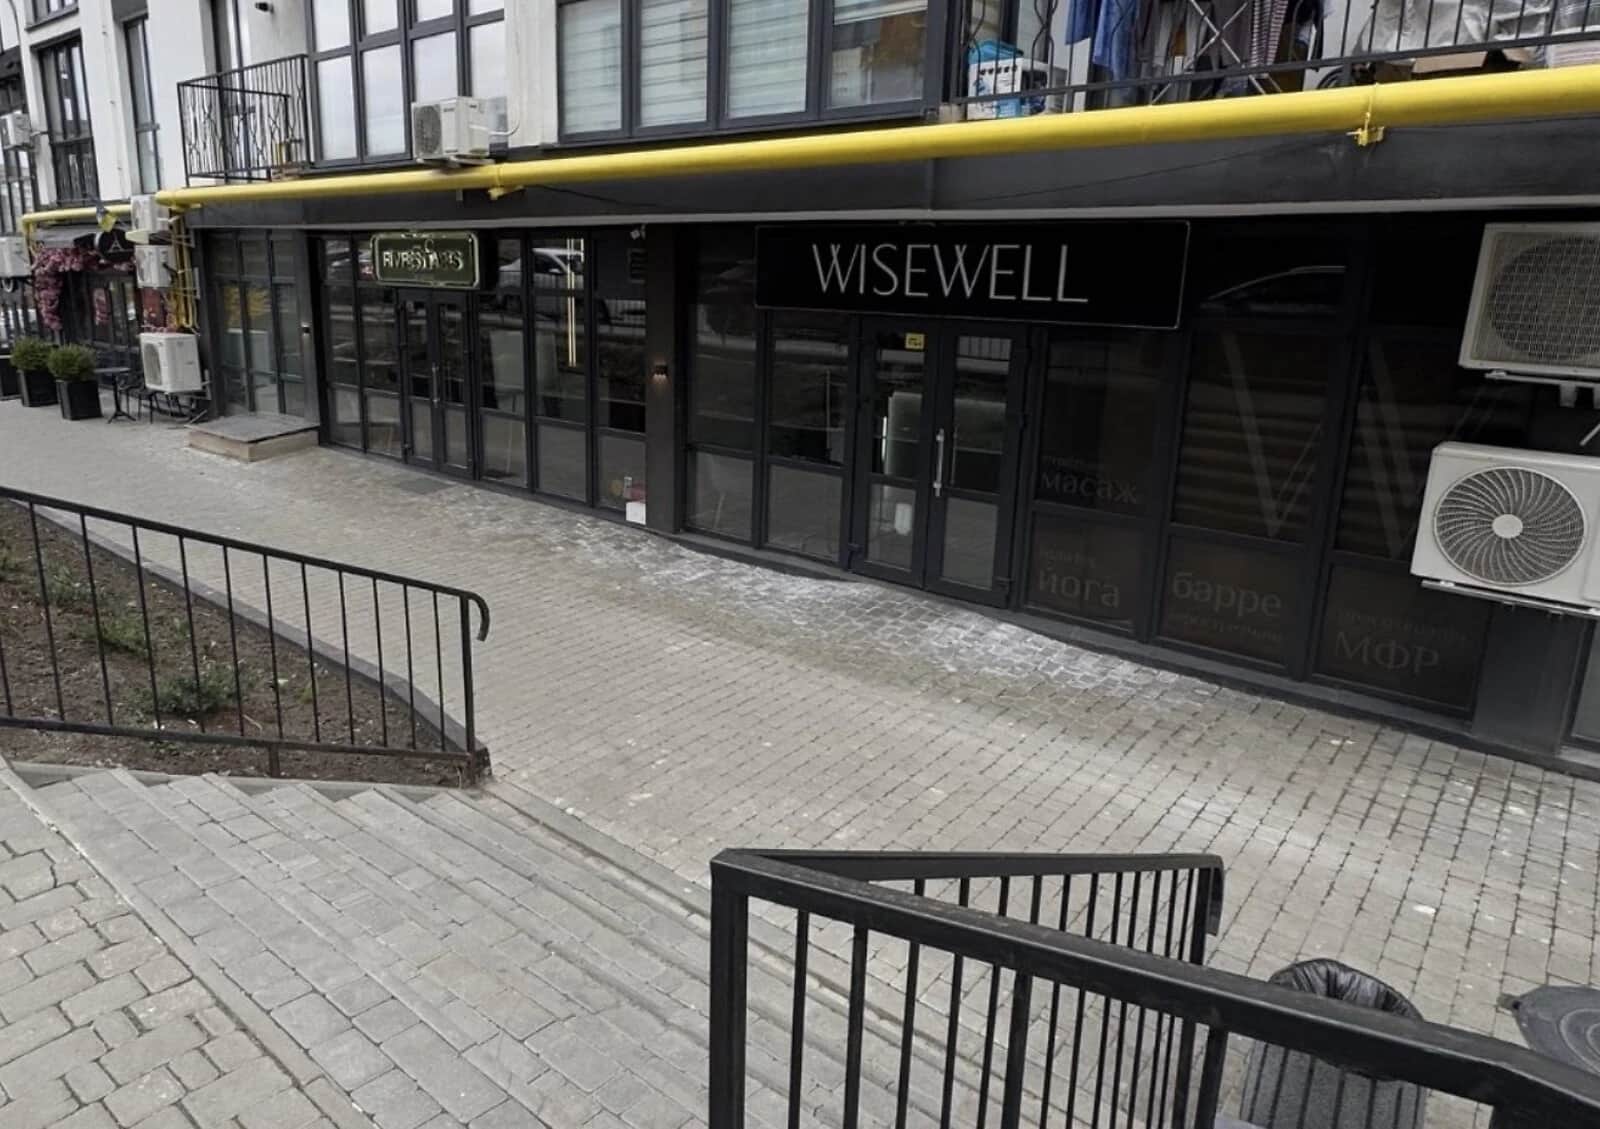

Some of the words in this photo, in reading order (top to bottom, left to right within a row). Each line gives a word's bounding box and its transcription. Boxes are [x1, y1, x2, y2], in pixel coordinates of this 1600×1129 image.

[812, 243, 1089, 304] WISEWELL
[1040, 471, 1138, 505] масаж
[1038, 567, 1121, 609] йога
[1172, 571, 1282, 617] барре
[1334, 631, 1441, 673] МФР
